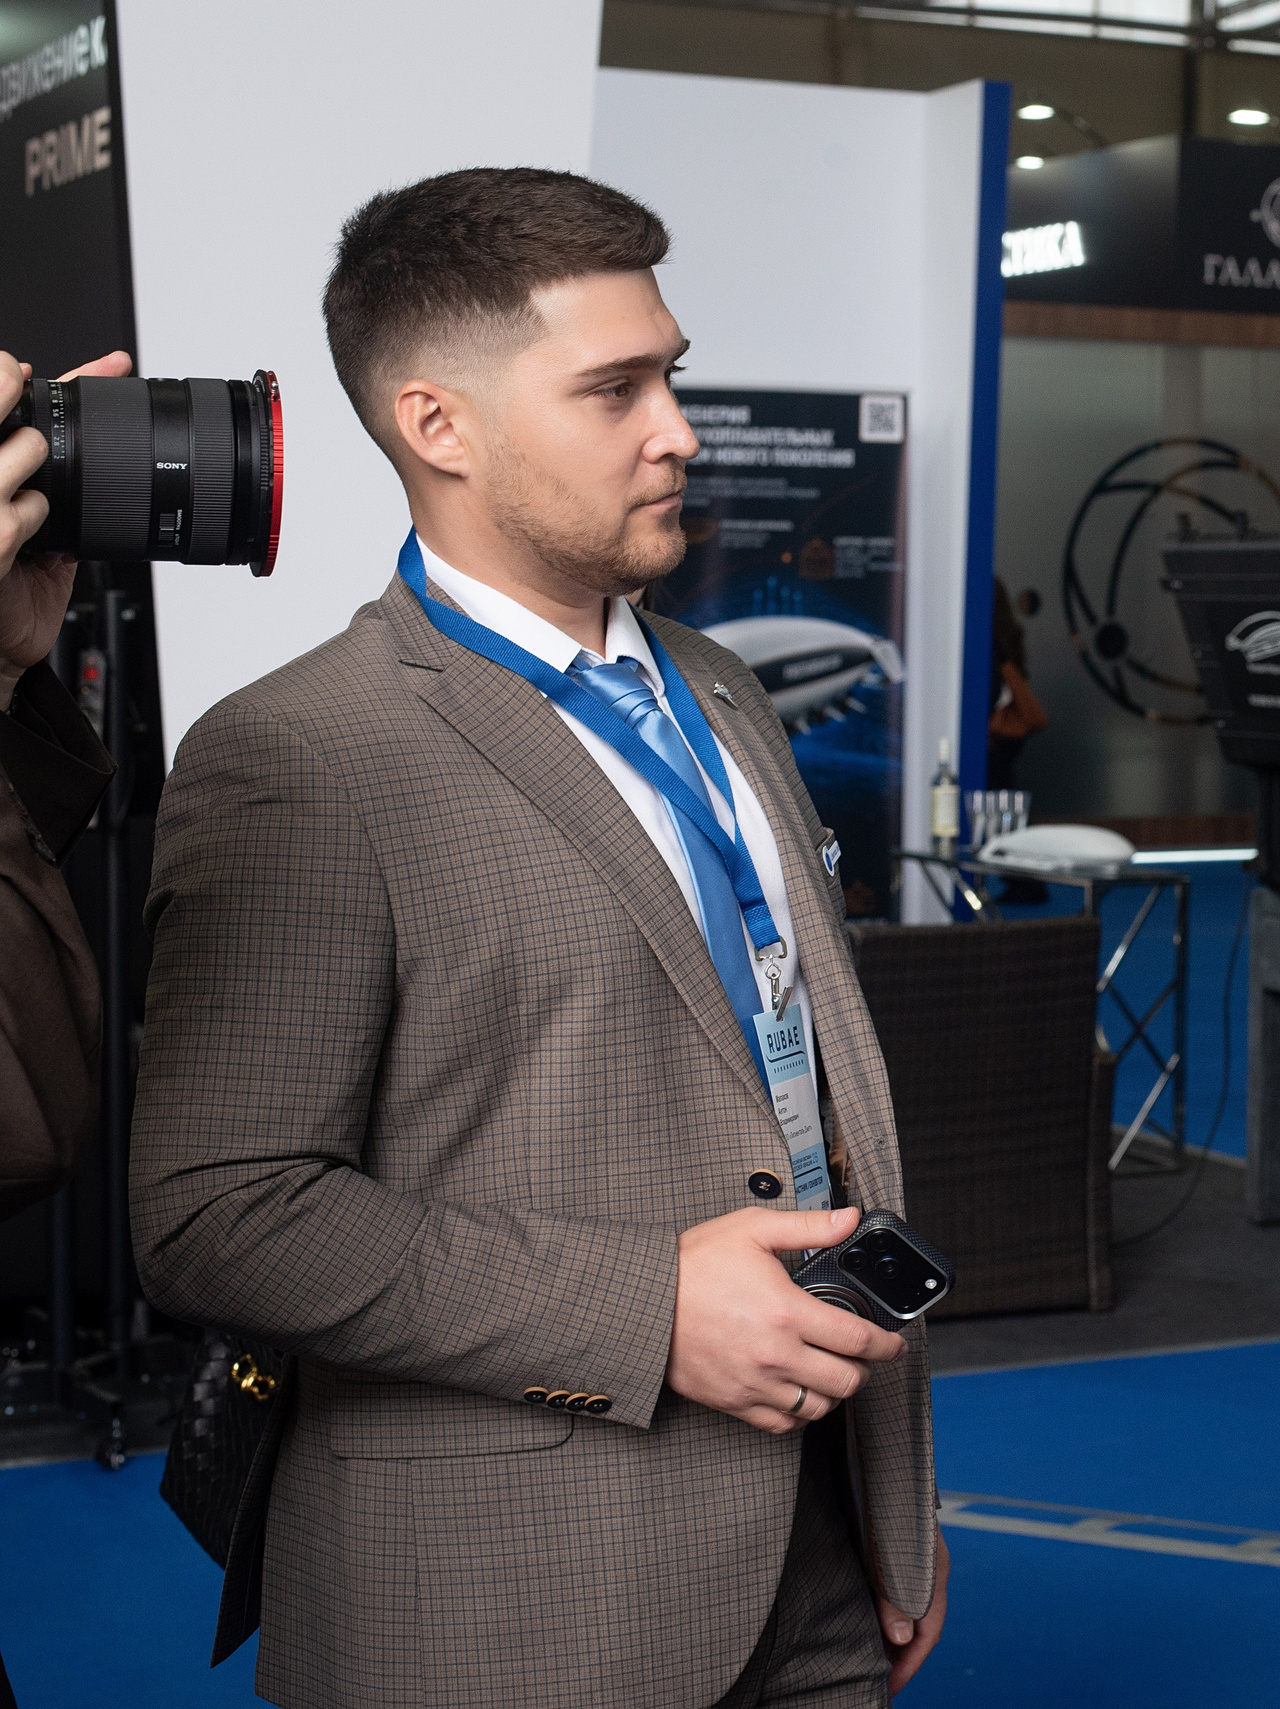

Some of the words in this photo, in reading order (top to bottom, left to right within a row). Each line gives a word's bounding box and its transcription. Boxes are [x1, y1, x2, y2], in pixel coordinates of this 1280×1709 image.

[25, 105, 111, 197] PRIME
[156, 462, 188, 470] SONY
[766, 1025, 800, 1054] RUBAE
